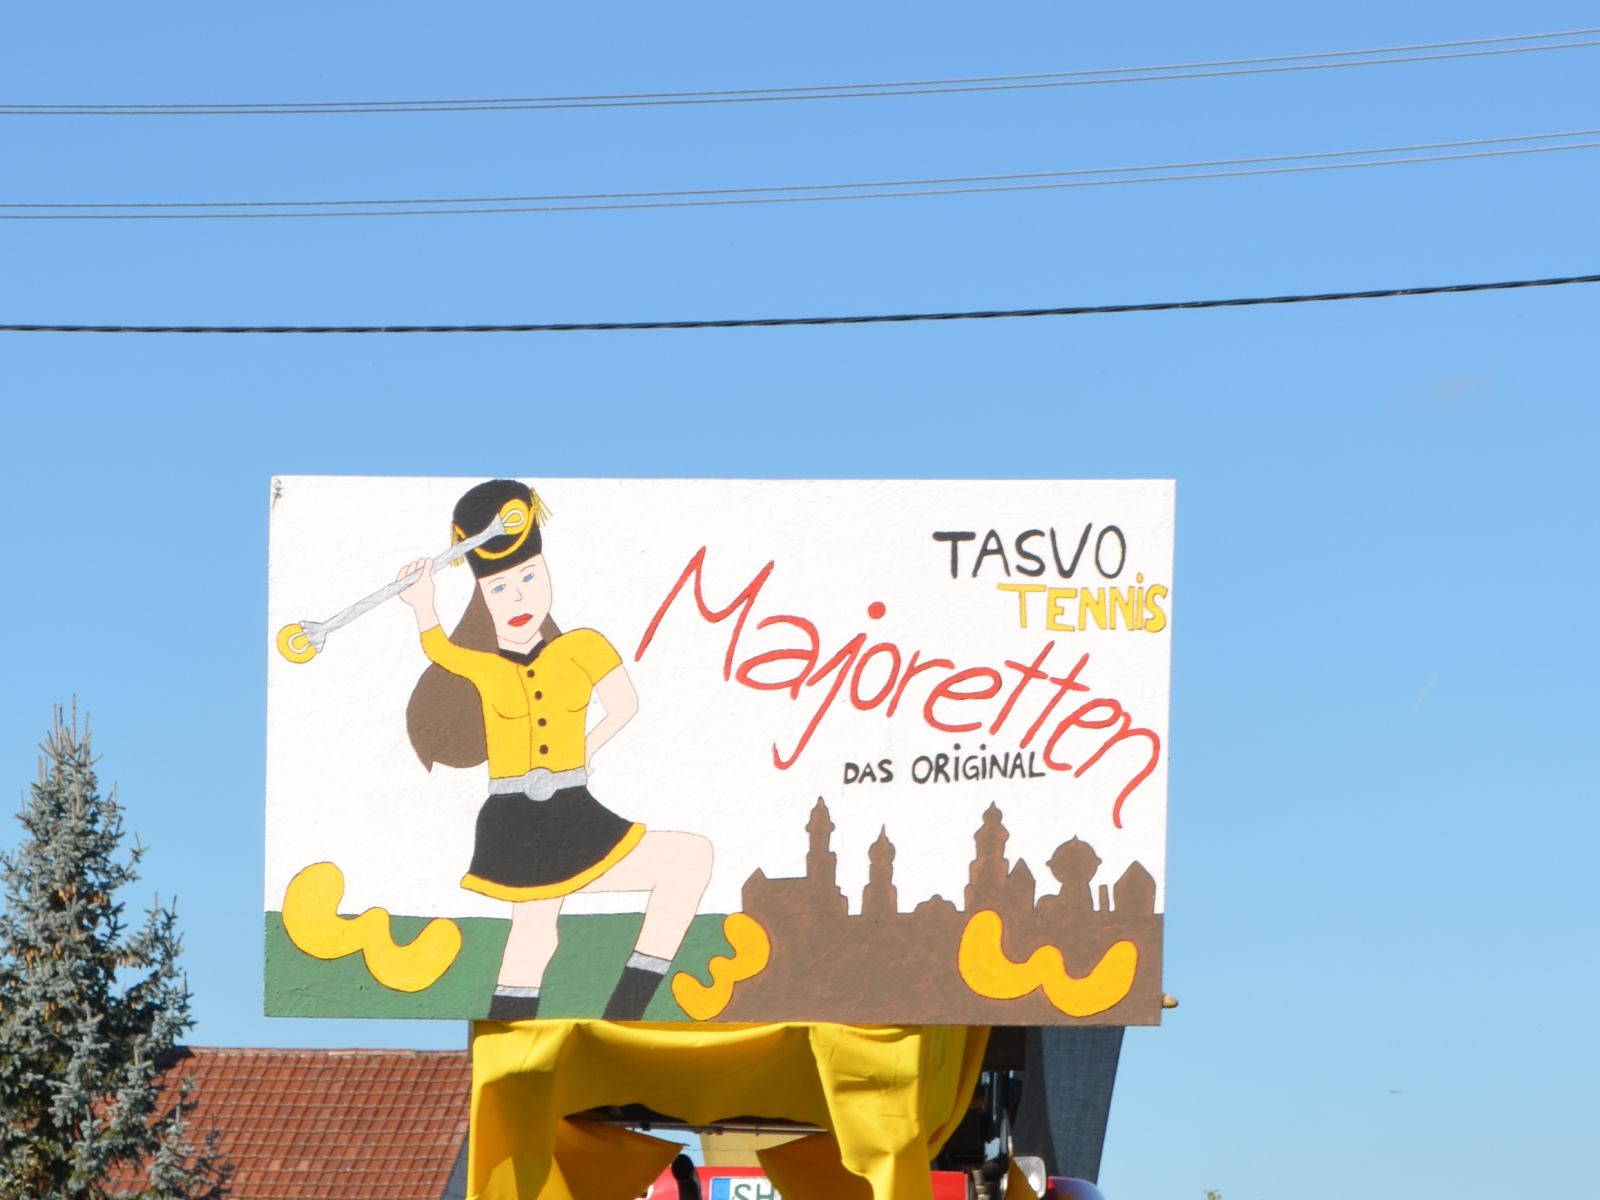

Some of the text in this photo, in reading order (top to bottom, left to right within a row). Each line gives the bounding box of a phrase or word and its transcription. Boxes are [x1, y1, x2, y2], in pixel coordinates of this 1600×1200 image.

[932, 522, 1127, 580] TASVO
[635, 545, 1161, 828] Majoretten
[843, 758, 894, 785] DAS
